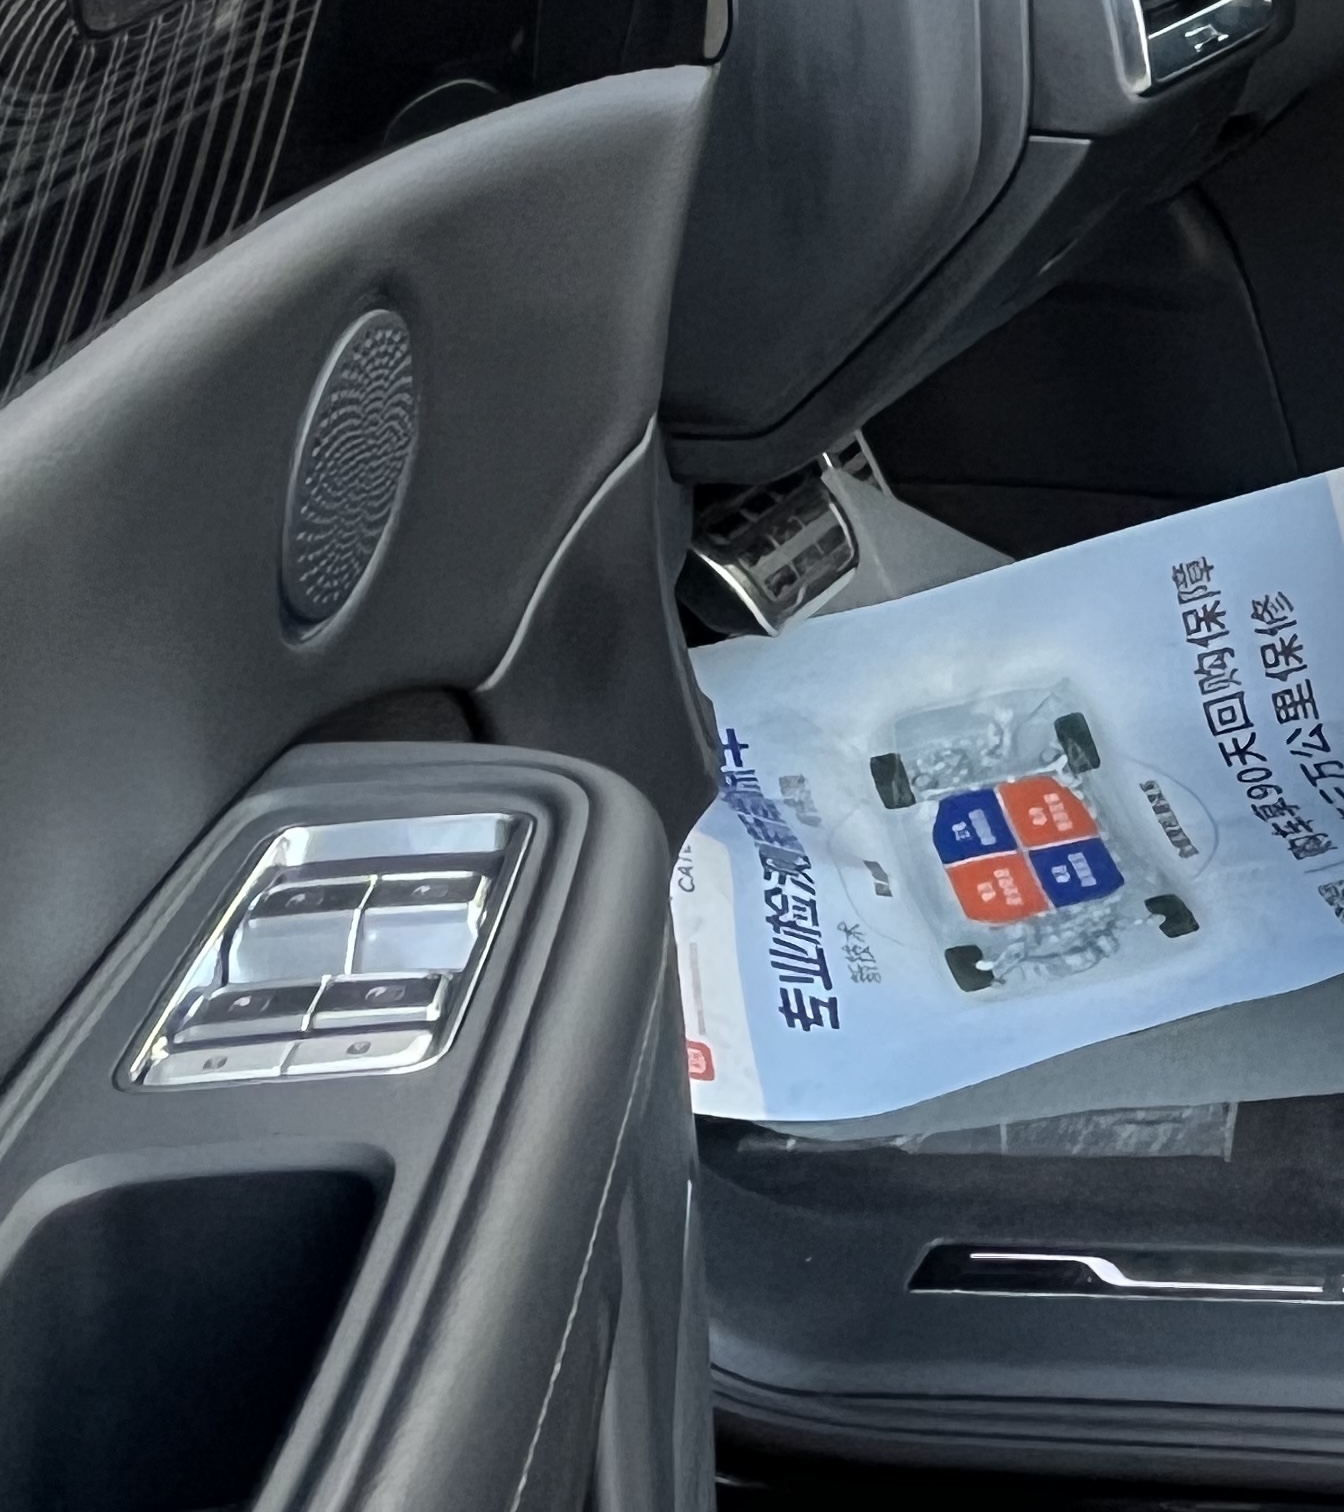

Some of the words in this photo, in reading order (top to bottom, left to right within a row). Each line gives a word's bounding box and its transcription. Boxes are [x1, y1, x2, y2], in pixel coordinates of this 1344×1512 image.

[1171, 556, 1338, 861] 购车享90天回购保障
